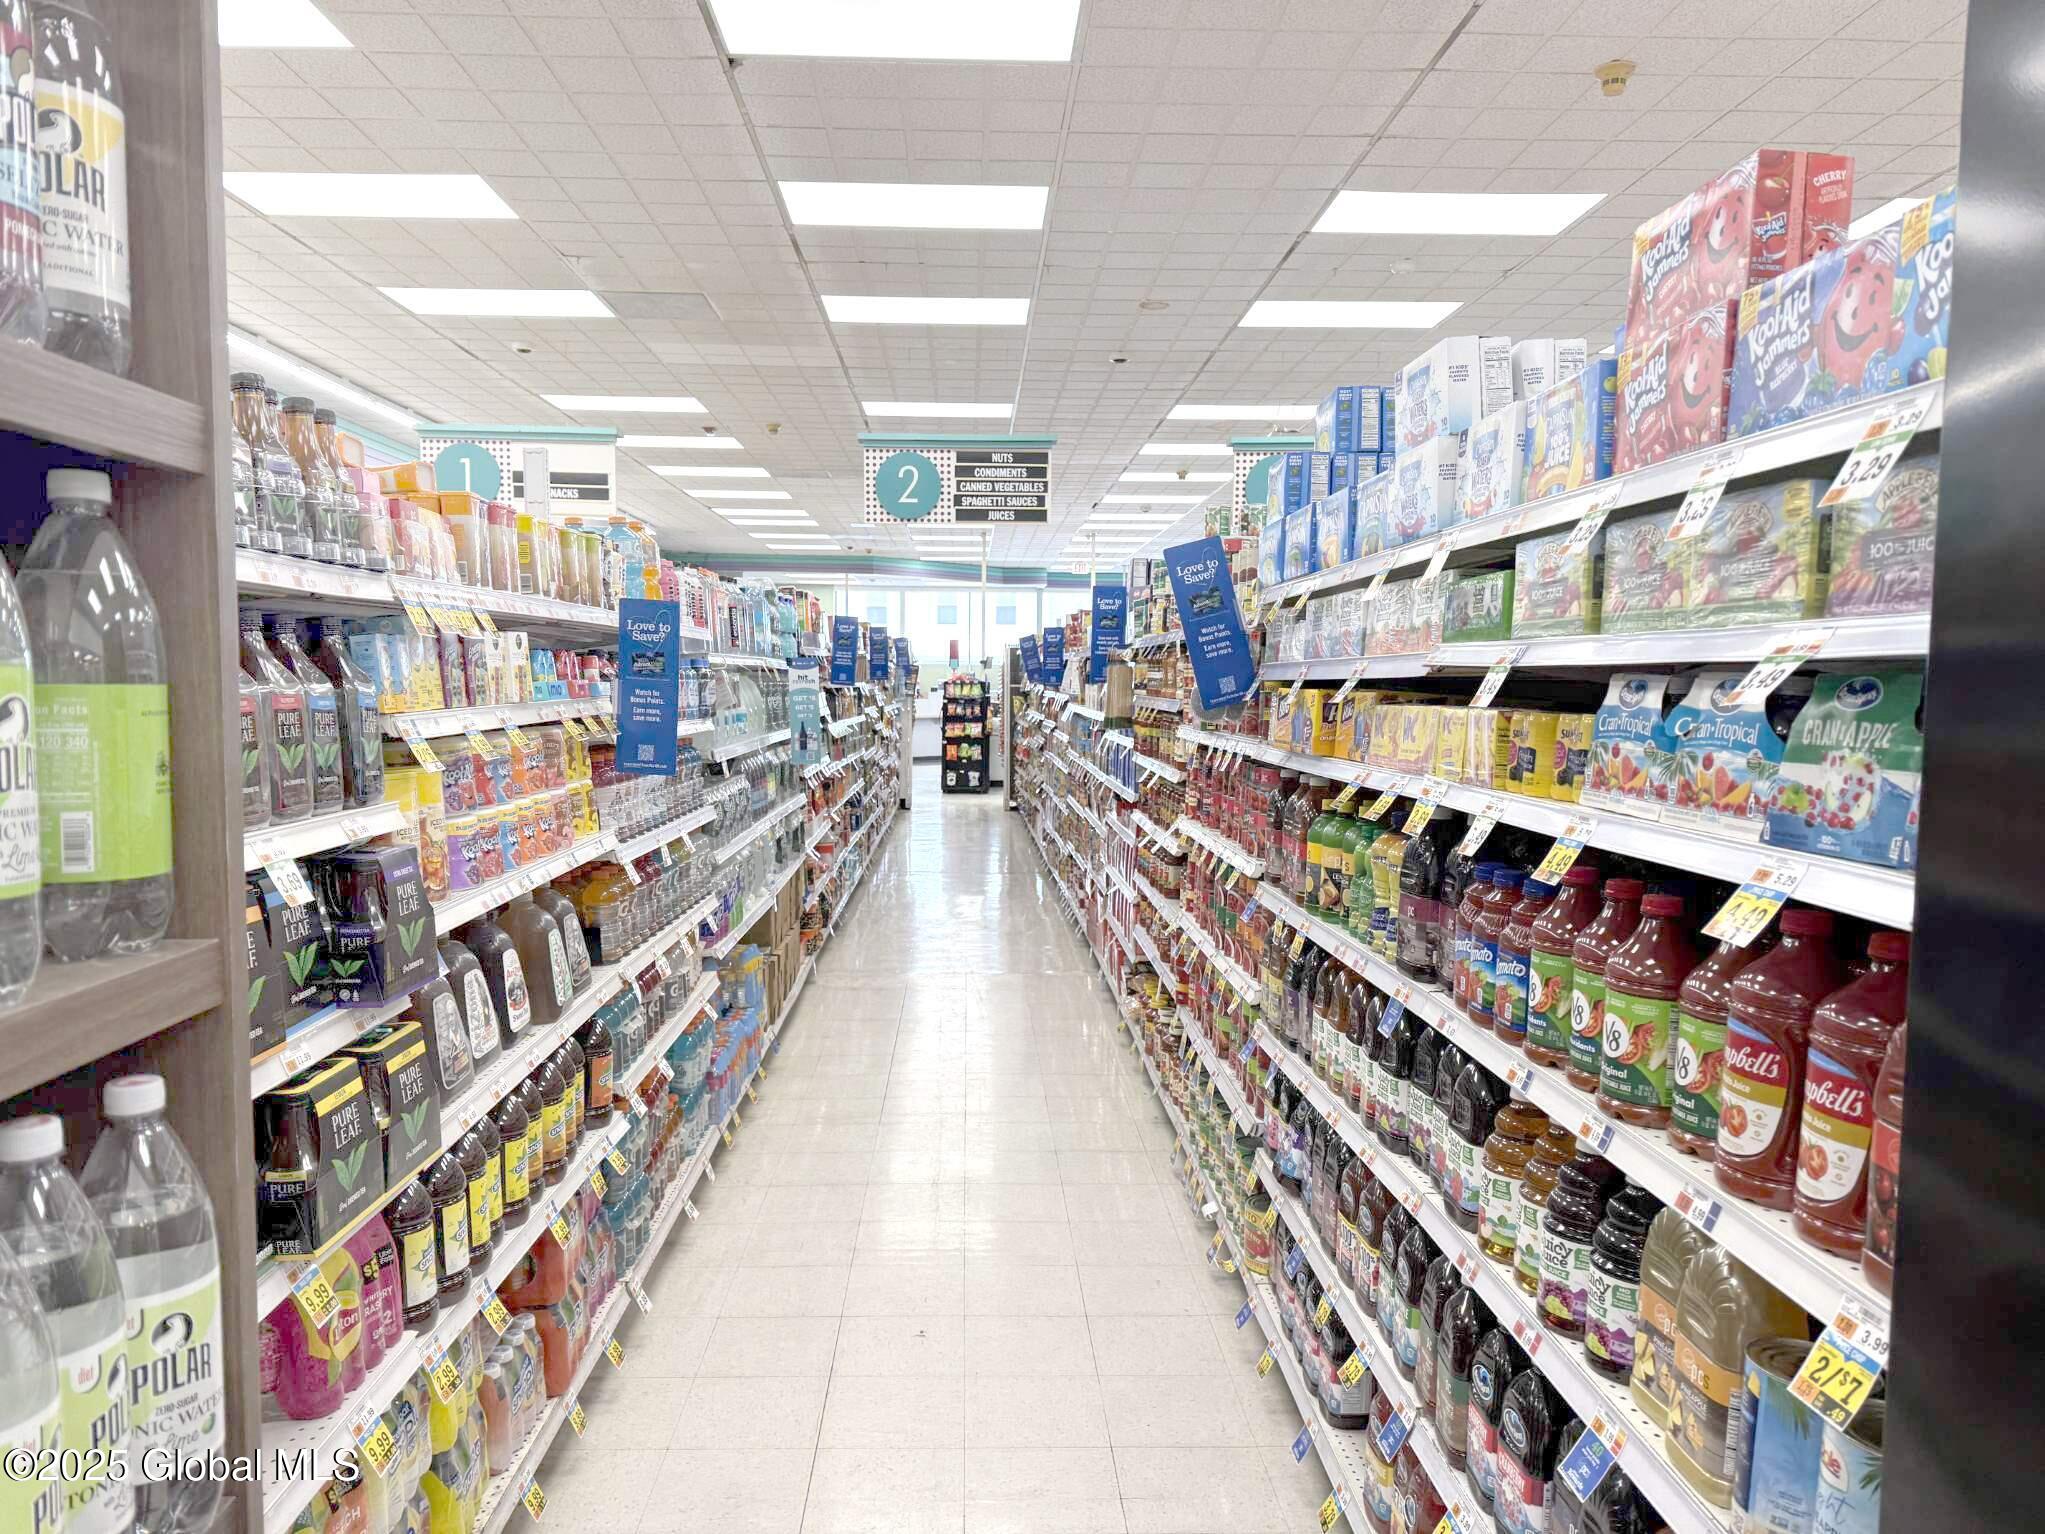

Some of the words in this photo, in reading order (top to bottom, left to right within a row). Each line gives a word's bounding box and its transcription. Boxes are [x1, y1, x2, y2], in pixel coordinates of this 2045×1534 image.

[1813, 168, 1847, 187] CHERRY
[64, 222, 125, 257] WATER
[1643, 219, 1691, 274] Kool-Aid
[1645, 239, 1690, 303] Jammers
[1751, 278, 1812, 363] Kool-Aid
[1755, 316, 1811, 387] Jammers
[1625, 347, 1667, 415] Kool-Aid
[1628, 376, 1668, 433] Jammers
[1894, 409, 1923, 428] 3.29
[992, 453, 1013, 463] NUTS
[1839, 451, 1894, 488] 3.29
[459, 457, 471, 492] 1
[898, 465, 919, 503] 2
[974, 467, 1027, 478] CONDIMENTS
[549, 487, 579, 498] NACKS
[960, 482, 993, 491] CANNED
[994, 482, 1045, 492] VEGETABLES
[961, 497, 1006, 506] SPAGHETTI
[1006, 497, 1038, 506] SAUCES
[988, 511, 1015, 521] JUICES
[1176, 563, 1203, 577] Love
[1206, 559, 1219, 569] to
[1184, 569, 1217, 585] Save?
[1097, 597, 1114, 605] Love
[627, 619, 655, 631] Love
[659, 621, 671, 632] to
[632, 630, 665, 642] Save?
[1739, 668, 1786, 693] 3.49
[278, 711, 300, 725] PURE
[314, 712, 335, 725] PURE
[1546, 852, 1574, 872] 4.49
[277, 872, 303, 894] 3.69
[396, 880, 418, 899] PURE
[1774, 869, 1798, 888] 5.29
[282, 906, 310, 926] PURE
[1728, 901, 1770, 930] 4.49
[1572, 997, 1585, 1027] V8
[1604, 1020, 1623, 1053] V8
[398, 1062, 422, 1087] PURE
[1676, 1046, 1690, 1080] V8
[331, 1101, 360, 1132] PURE
[1812, 1116, 1832, 1133] Juice
[270, 1183, 304, 1194] PURE
[1544, 1226, 1573, 1261] uicy
[305, 1283, 329, 1310] 9.99
[1619, 1287, 1632, 1295] NO
[488, 1303, 505, 1324] 2.99
[1860, 1329, 1890, 1357] 3.99
[131, 1342, 212, 1406] POLAR
[436, 1364, 456, 1391] 2.99
[1807, 1355, 1864, 1407] 2/$7
[1680, 1382, 1708, 1412] PINEAPPLE
[1826, 1407, 1846, 1424] .49
[368, 1431, 391, 1457] 9.99
